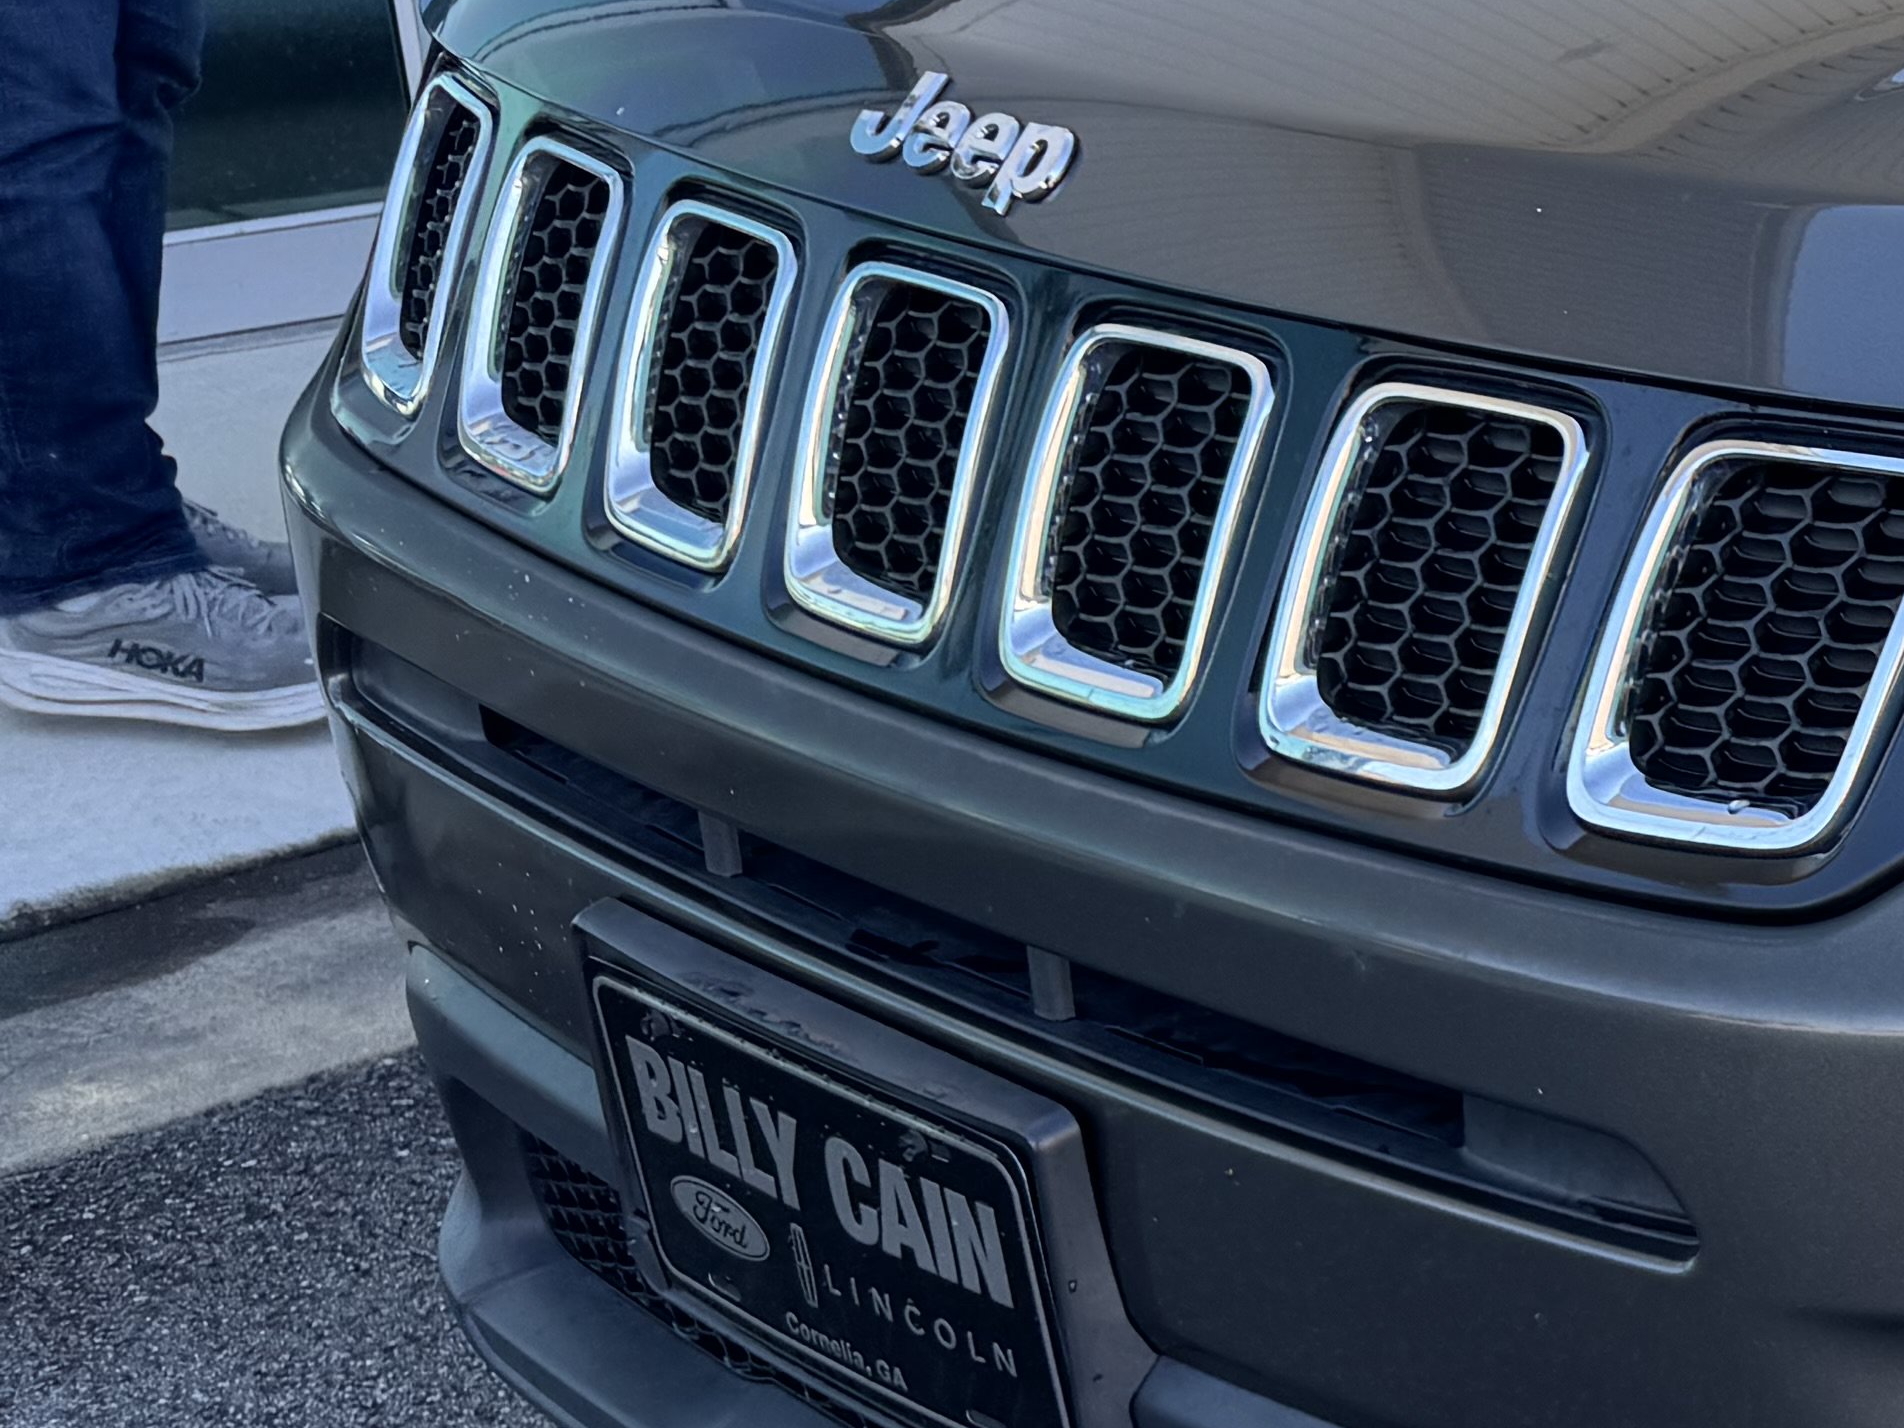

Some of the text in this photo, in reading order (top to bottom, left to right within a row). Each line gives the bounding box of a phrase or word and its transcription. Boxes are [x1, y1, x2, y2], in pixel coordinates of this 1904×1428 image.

[850, 70, 1079, 217] Jeep
[107, 638, 205, 683] HOKA
[625, 1033, 1015, 1310] BILLY CAIN
[692, 1190, 750, 1250] Ford
[785, 1310, 909, 1394] Cornelia, GA
[823, 1263, 1018, 1378] LINCOLN
